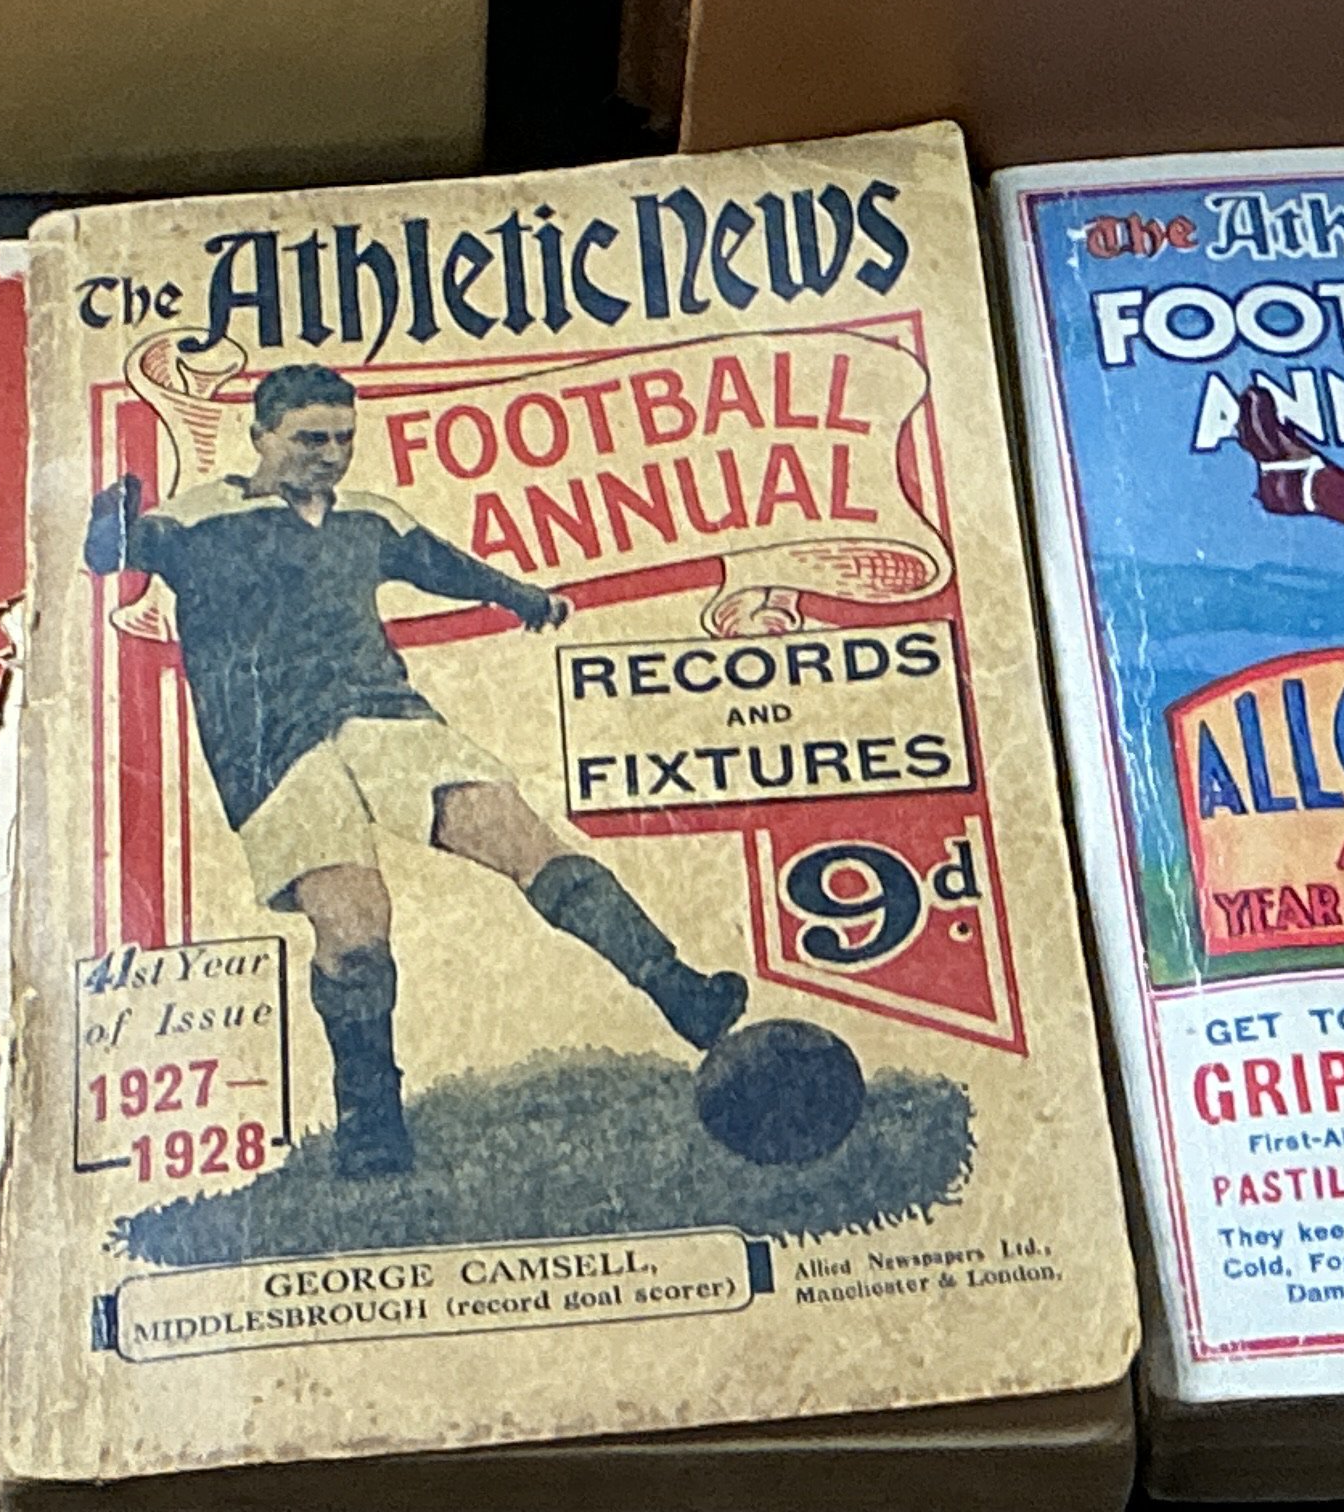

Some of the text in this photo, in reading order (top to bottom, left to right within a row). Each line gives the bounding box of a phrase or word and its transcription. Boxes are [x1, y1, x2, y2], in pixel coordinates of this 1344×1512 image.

[1085, 210, 1200, 260] The
[77, 178, 910, 363] The Athletic News
[385, 351, 872, 488] FOOTBALL
[469, 443, 878, 574] ANNUAL
[570, 633, 943, 700] RECORDS
[726, 700, 792, 727] AND
[577, 734, 952, 800] FIXTURES
[1213, 882, 1344, 937] YEAR
[84, 946, 270, 994] 41st Year
[85, 1002, 273, 1054] of Issue
[1205, 1012, 1282, 1046] GET
[795, 1258, 852, 1281] Allied
[868, 1246, 985, 1272] Newspapers
[1219, 1227, 1284, 1249] They
[264, 1249, 658, 1298] GEORGE CAMSELL,
[938, 1271, 956, 1289] &
[132, 1276, 737, 1345] MIDDLESBROUGH (record goal scorer)
